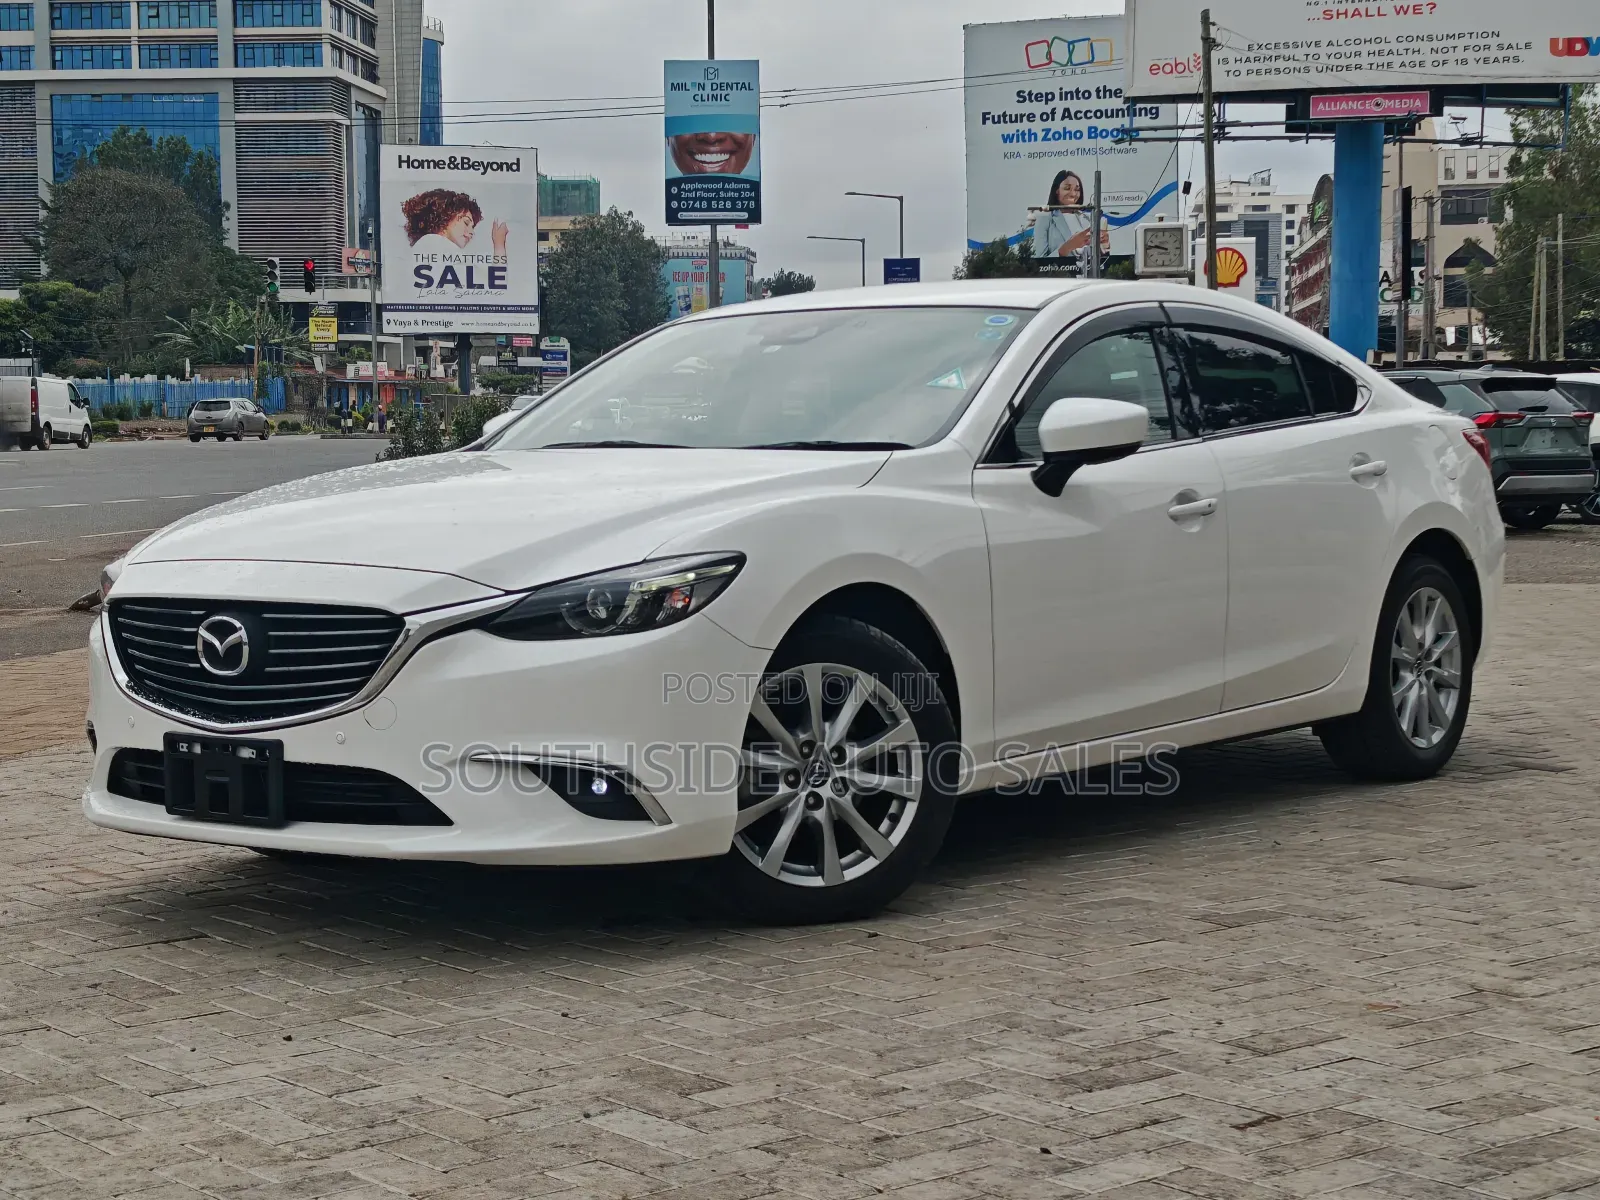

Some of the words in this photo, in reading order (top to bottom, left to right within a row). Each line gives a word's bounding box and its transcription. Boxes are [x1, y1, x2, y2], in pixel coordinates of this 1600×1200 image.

[1307, 6, 1388, 21] ...SHALL
[1393, 2, 1437, 16] WE?
[1247, 40, 1322, 51] EXCESSIVE
[1325, 36, 1392, 47] ALCOHOL
[1395, 30, 1500, 43] CONSUMPTION
[1217, 57, 1230, 65] IS
[1234, 54, 1300, 64] HARMFUL
[1303, 53, 1321, 61] TO
[1325, 51, 1362, 60] YOUR
[1430, 46, 1458, 54] NOT
[1463, 44, 1491, 52] FOR
[1496, 42, 1533, 51] SALE
[1149, 56, 1194, 75] eabl
[1224, 69, 1241, 77] TO
[1246, 66, 1311, 76] PERSONS
[1315, 64, 1363, 73] UNDER
[1367, 61, 1394, 70] THE
[1398, 60, 1426, 68] AGE
[1431, 59, 1450, 67] OF
[1454, 58, 1469, 66] 18
[670, 82, 705, 91] MILN
[710, 82, 754, 91] DENTAL
[692, 93, 731, 102] CLINIC
[1016, 89, 1055, 105] Step
[1058, 87, 1092, 101] into
[1095, 85, 1123, 99] the
[1317, 100, 1372, 111] ALLIANCE
[1384, 98, 1422, 109] MEDIA
[981, 111, 1036, 125] Future
[1039, 107, 1057, 122] of
[1060, 104, 1160, 121] Accounting
[1001, 129, 1038, 143] with
[1041, 127, 1084, 142] Zoho
[1003, 151, 1022, 160] KRA
[1027, 149, 1069, 160] approved
[1069, 147, 1097, 157] eTIMS
[1097, 146, 1138, 156] Software
[397, 154, 521, 175] Home&Beyond
[680, 182, 723, 190] Applewood
[680, 200, 708, 209] 0748
[711, 200, 732, 209] 528
[735, 200, 755, 209] 378
[1124, 194, 1144, 202] ready
[413, 253, 438, 263] THE
[442, 254, 508, 264] MATTRESS
[413, 264, 508, 289] SALE
[672, 271, 681, 283] ICE
[682, 271, 689, 283] UP
[691, 271, 705, 282] YOUR
[393, 319, 412, 328] Yaya
[413, 319, 420, 327] &
[421, 319, 454, 329] Prestige
